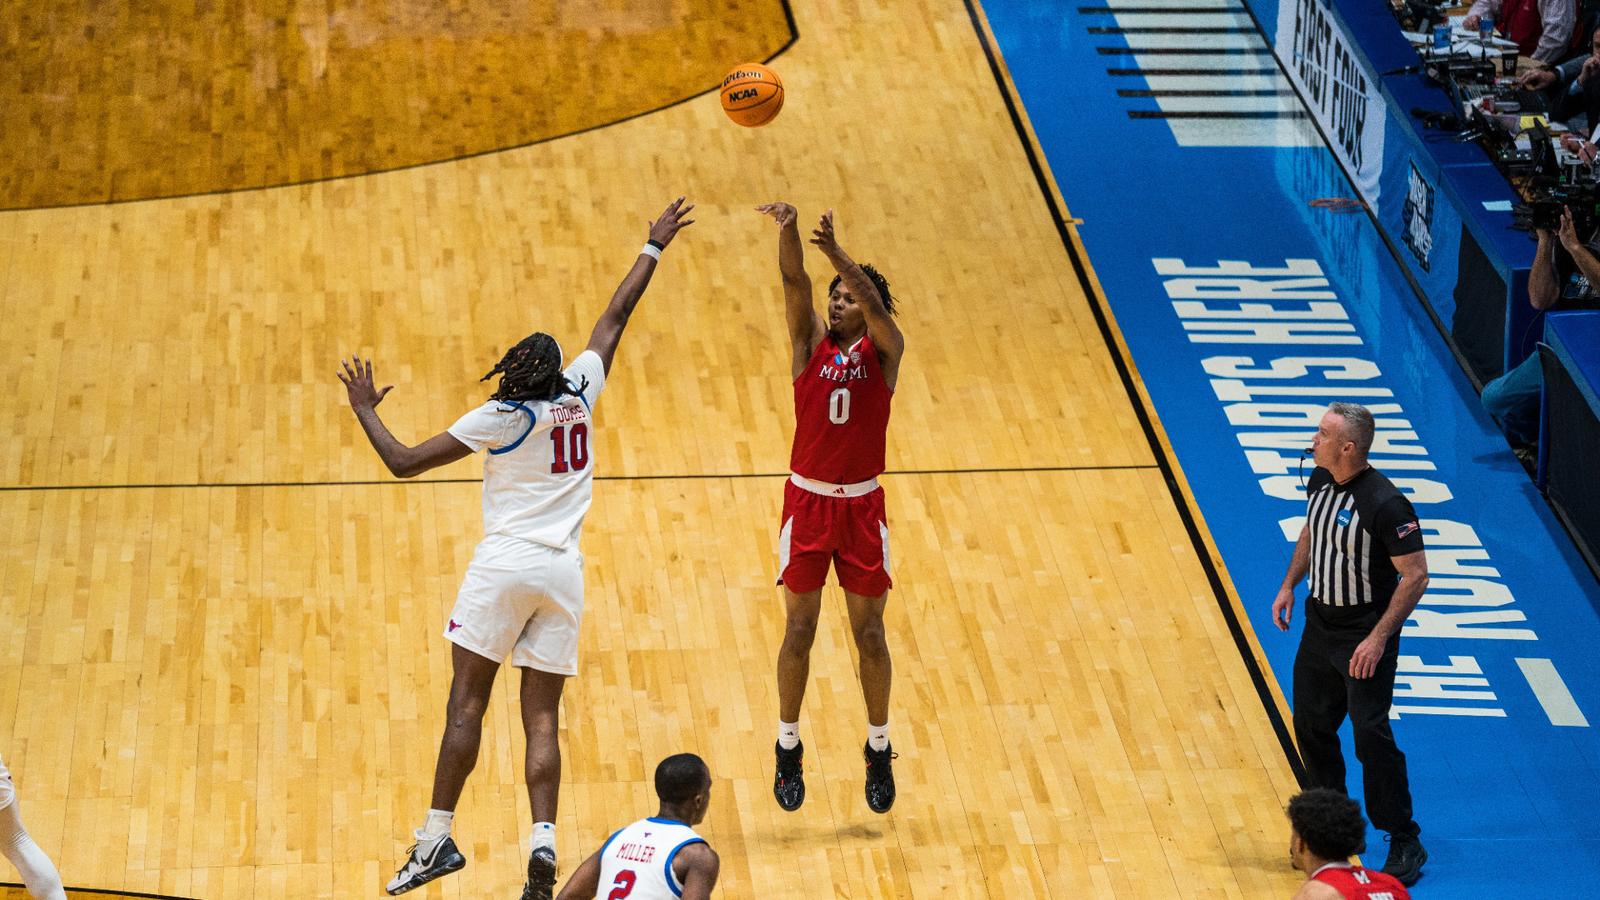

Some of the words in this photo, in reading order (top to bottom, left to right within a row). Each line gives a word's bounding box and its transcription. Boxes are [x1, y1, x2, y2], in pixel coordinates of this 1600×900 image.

[730, 88, 758, 102] NCAA
[1293, 0, 1332, 116] FIRST
[1331, 36, 1367, 176] FOUR
[1152, 257, 1364, 345] HERE
[819, 364, 868, 382] MIAMI
[829, 387, 851, 425] 0
[550, 422, 589, 474] 10
[1201, 356, 1454, 504] STARTS
[1390, 655, 1508, 720] THE
[616, 843, 656, 862] MILLER
[607, 869, 637, 900] 2
